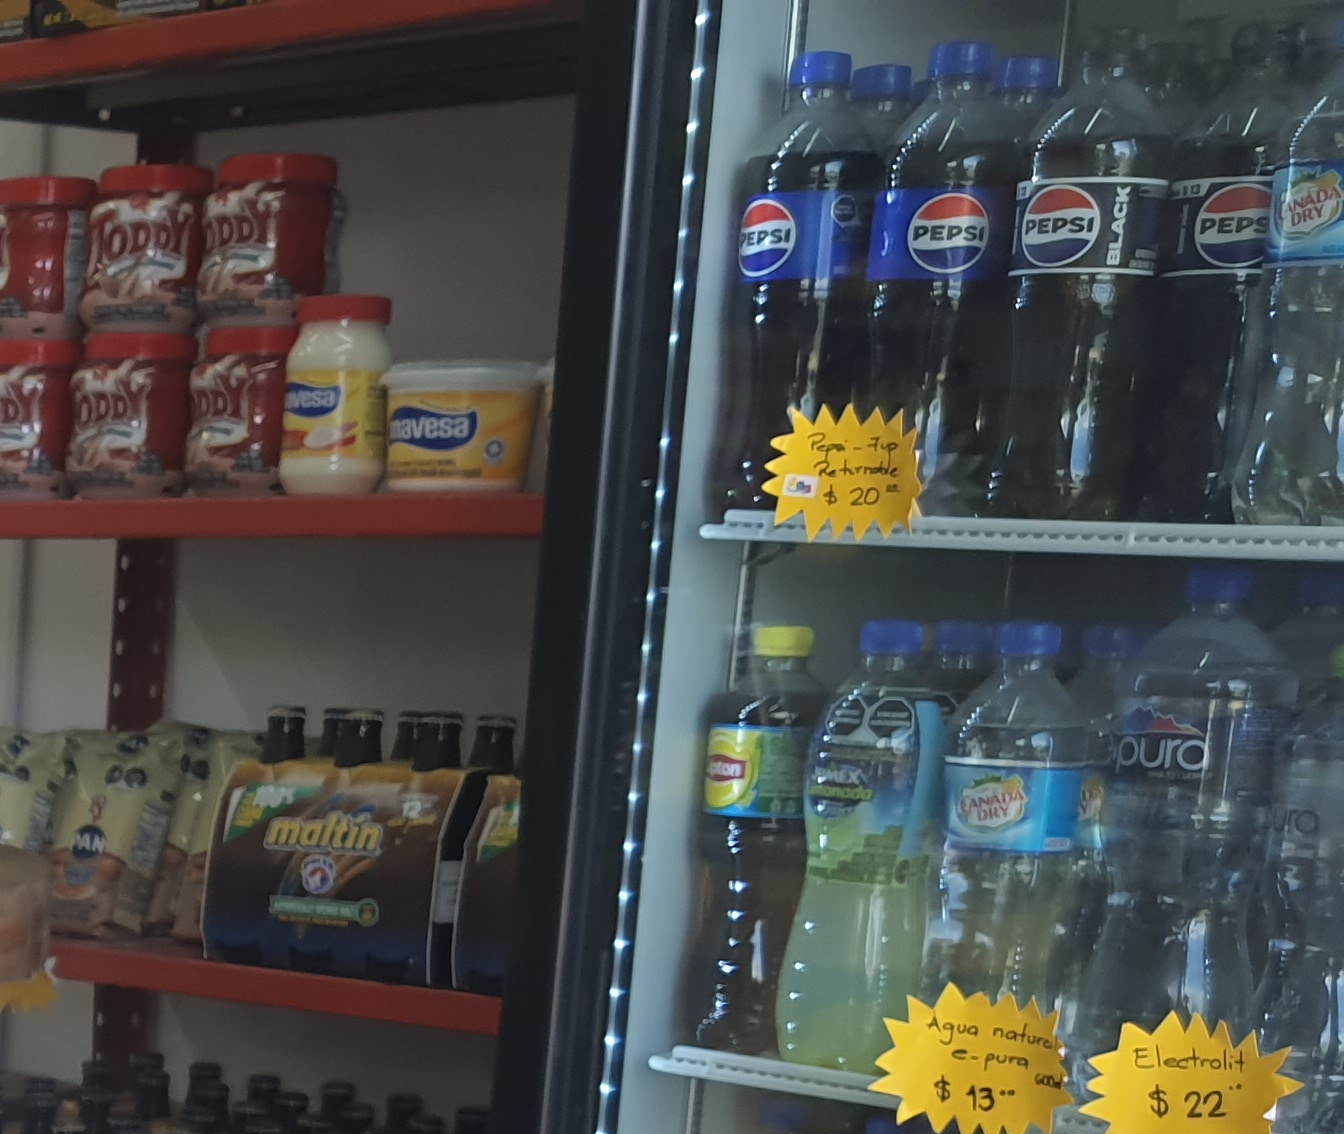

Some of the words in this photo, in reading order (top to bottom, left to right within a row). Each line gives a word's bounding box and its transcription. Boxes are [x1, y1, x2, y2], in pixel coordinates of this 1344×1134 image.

[1025, 216, 1096, 235] PEPSI
[1106, 186, 1131, 265] BLACK
[1199, 216, 1271, 235] PEPS
[1291, 204, 1324, 227] DRY
[740, 227, 791, 248] PEPSI
[912, 224, 986, 242] PEPSI
[823, 484, 838, 507] $
[977, 804, 1010, 822] DRY
[926, 1017, 979, 1047] Agua
[992, 1023, 1058, 1053] natural
[1133, 1047, 1245, 1072] Electrolit
[933, 1073, 951, 1104] $
[1149, 1083, 1169, 1119] $
